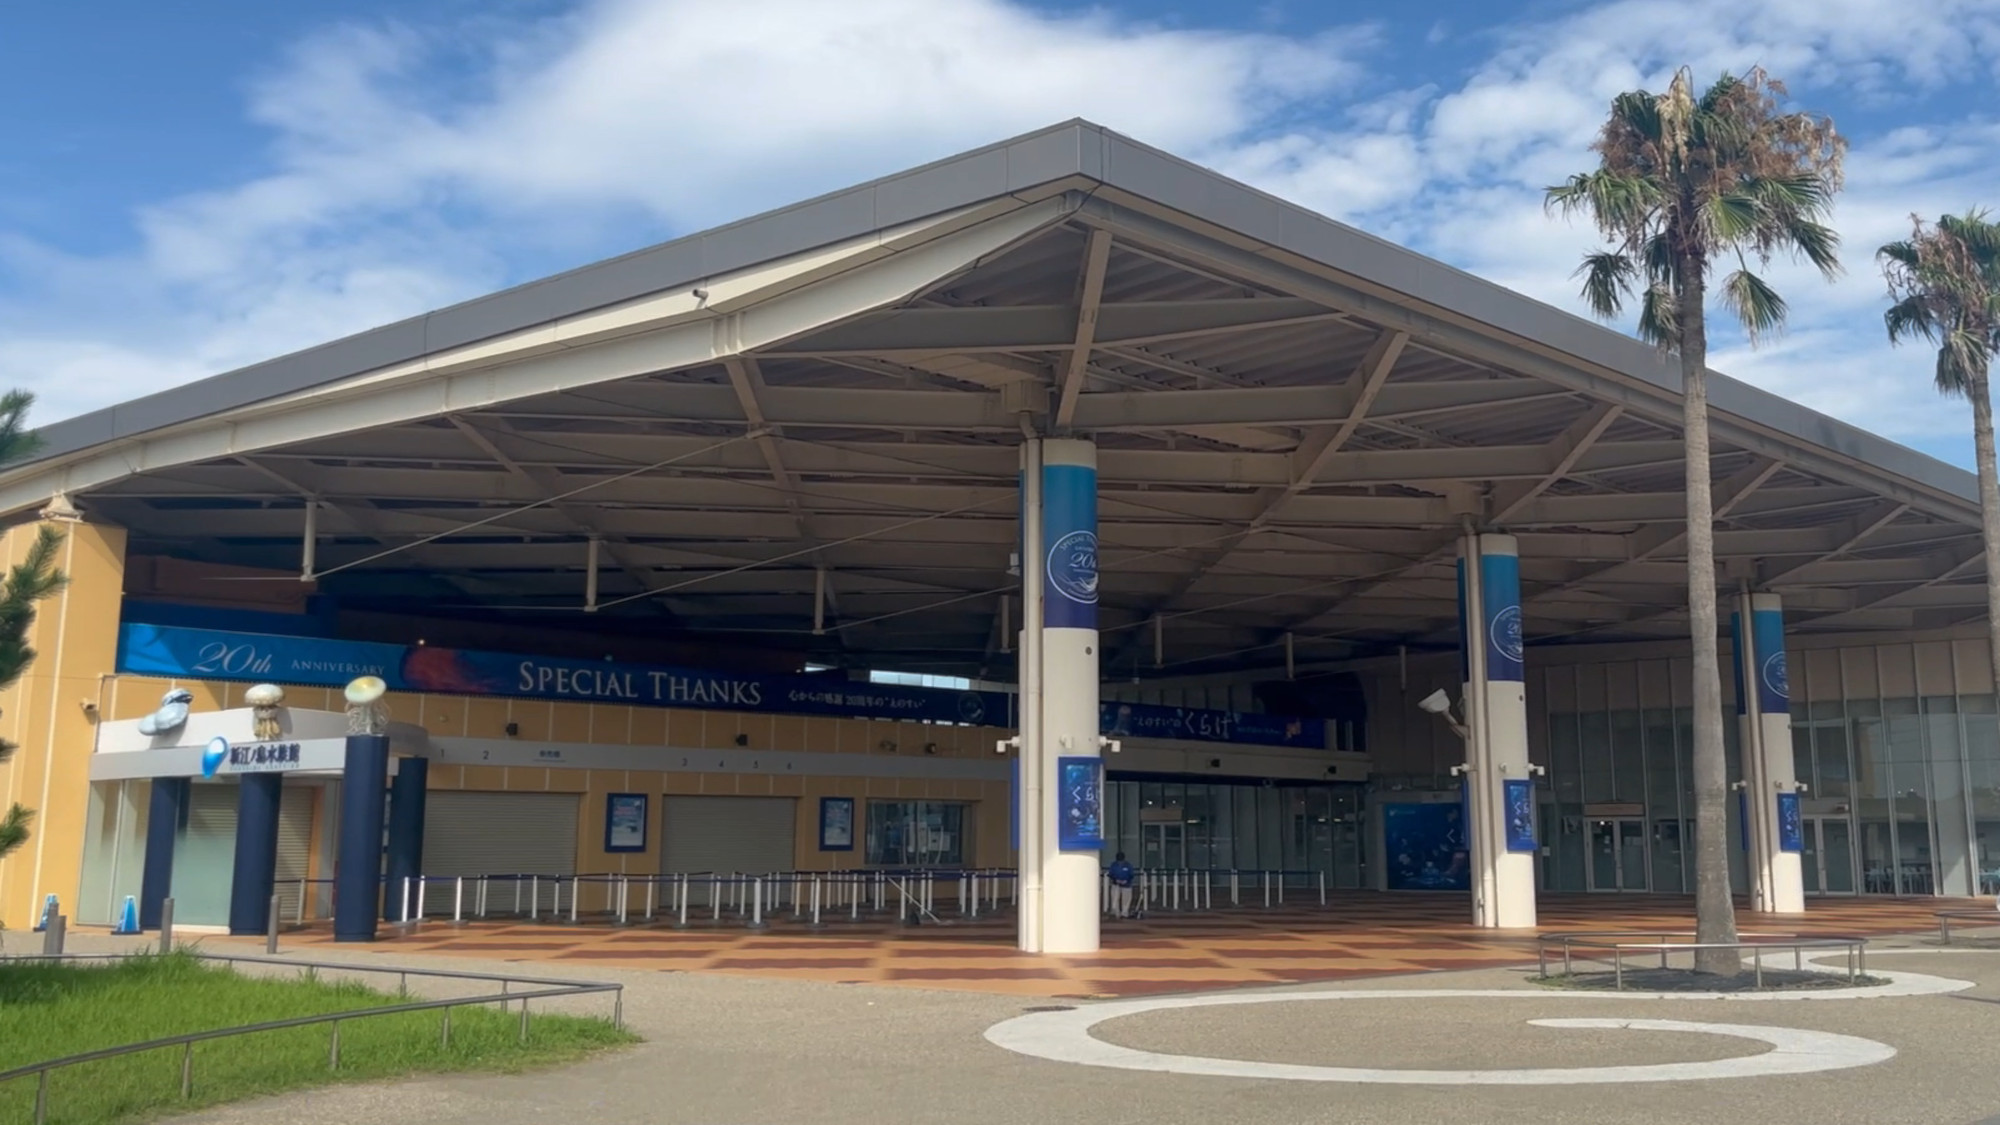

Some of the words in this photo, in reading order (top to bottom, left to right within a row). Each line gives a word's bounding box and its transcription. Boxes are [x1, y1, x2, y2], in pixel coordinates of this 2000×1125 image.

[191, 642, 273, 674] 20th
[291, 658, 386, 676] ANNIVERSARY
[519, 661, 639, 699] SPECIAL
[648, 671, 762, 705] THANKS
[482, 750, 490, 760] 2
[681, 757, 688, 767] 3
[718, 759, 725, 768] 4
